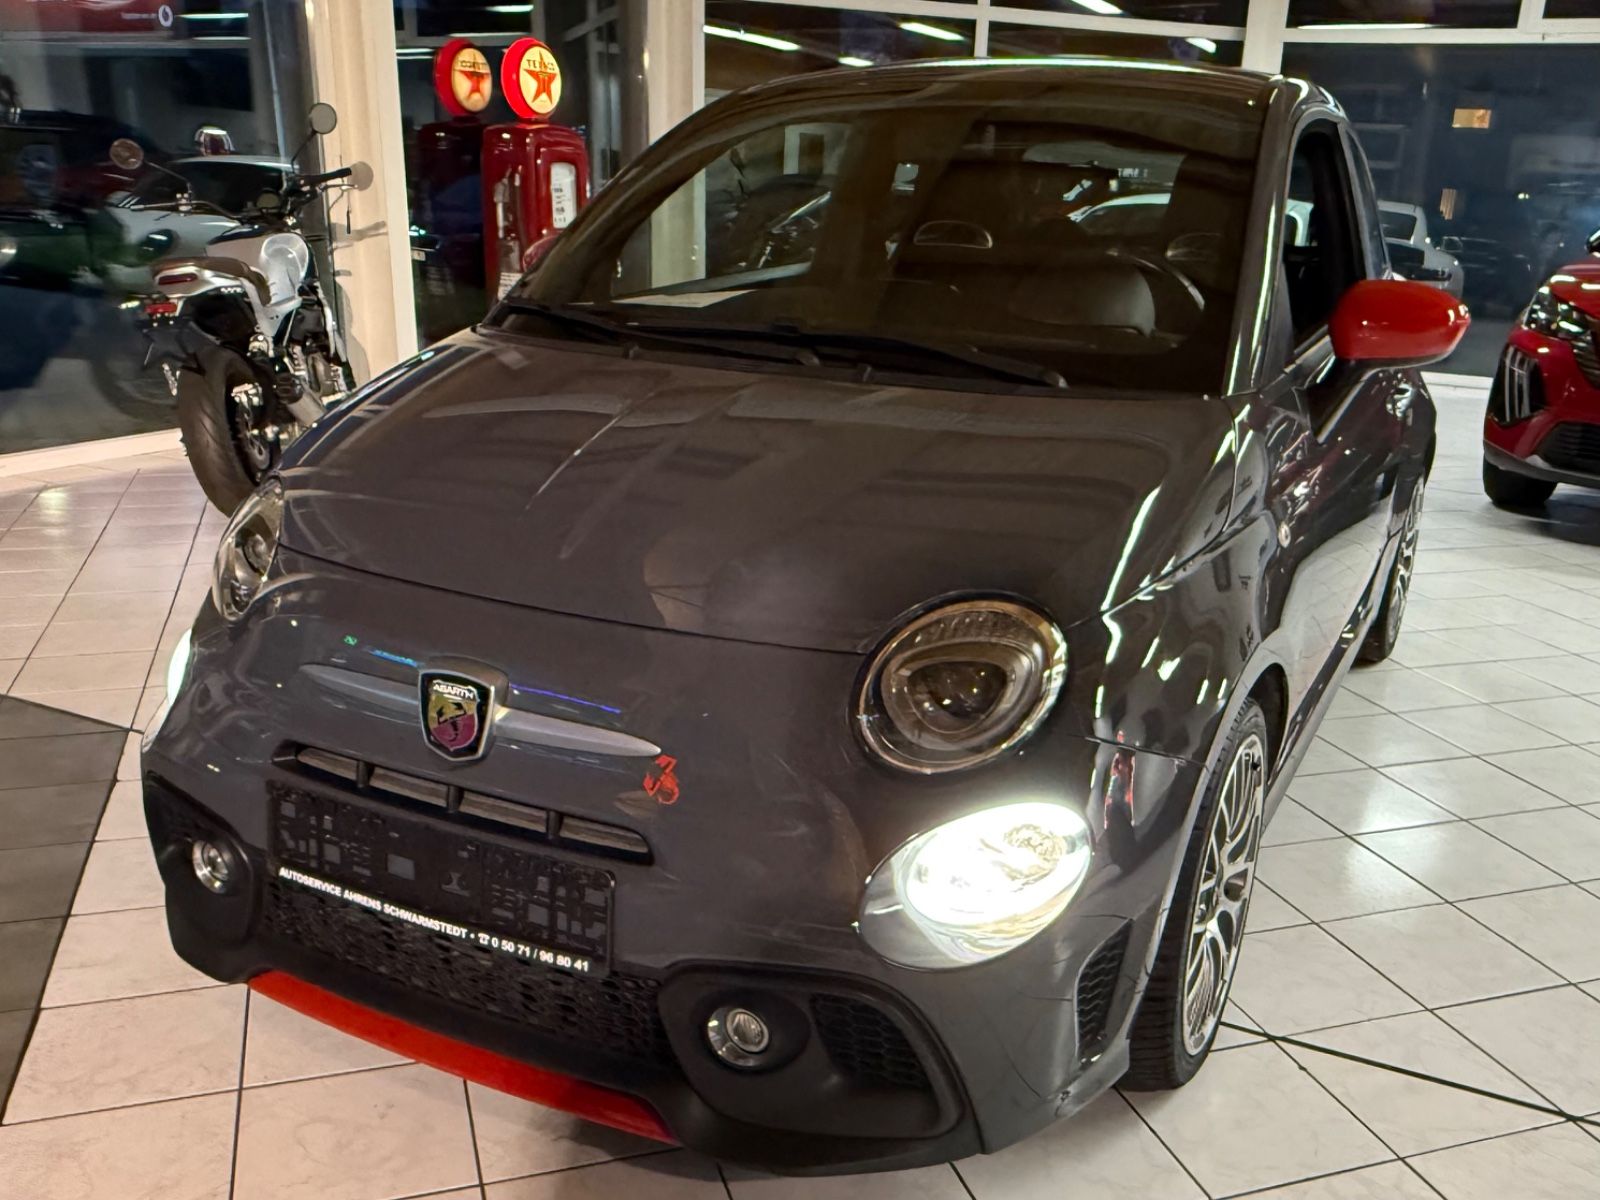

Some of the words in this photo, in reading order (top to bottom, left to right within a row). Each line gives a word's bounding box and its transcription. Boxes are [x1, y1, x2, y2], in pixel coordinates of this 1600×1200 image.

[433, 684, 474, 699] ABARTH
[278, 866, 342, 897] AUTOSERVICE
[343, 889, 382, 911] AHRENS
[383, 903, 468, 939] SCHWARMSTEDT
[491, 937, 499, 948] 0
[501, 939, 515, 952] 50
[517, 944, 530, 958] 71
[539, 950, 554, 963] 96
[573, 959, 589, 972] 41
